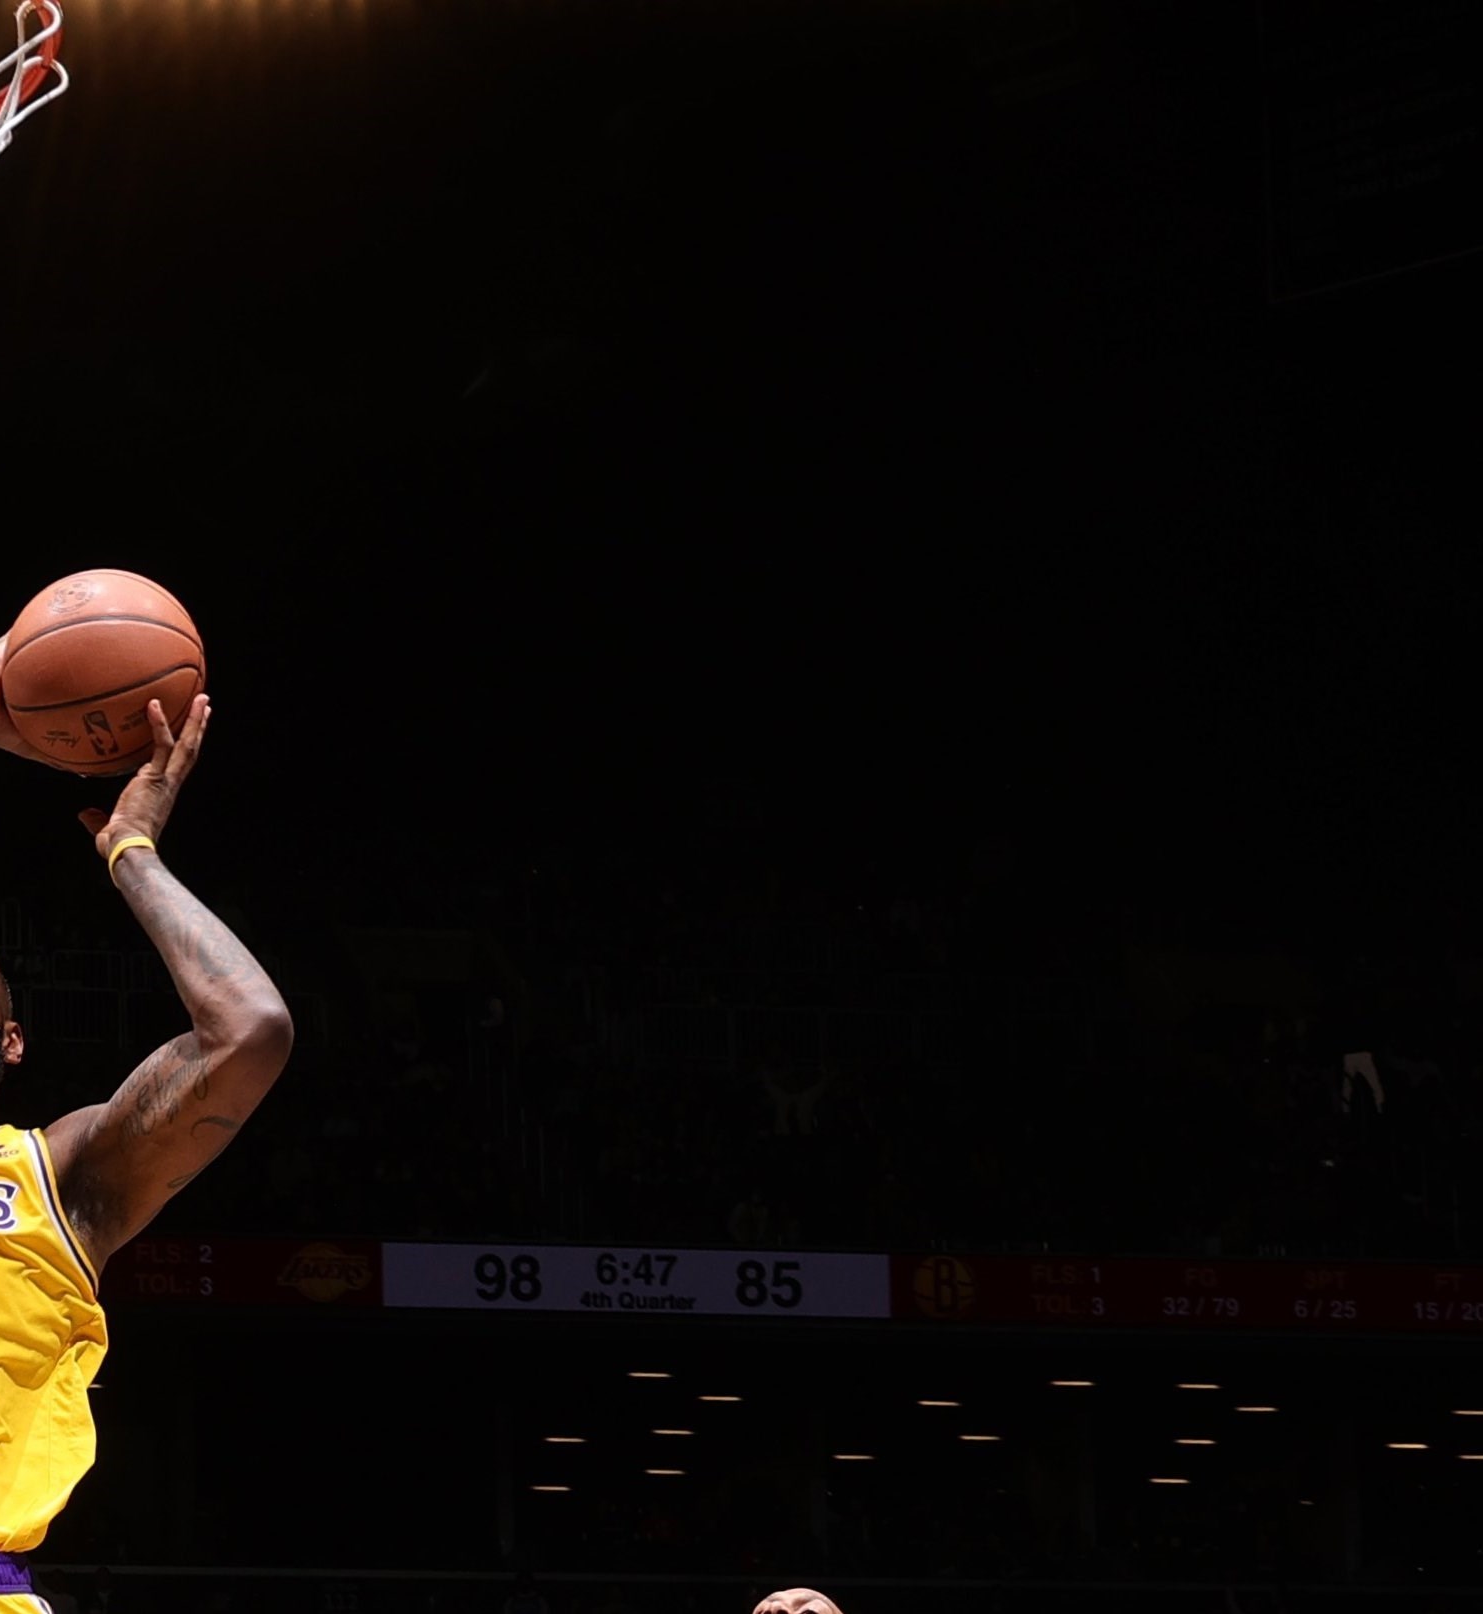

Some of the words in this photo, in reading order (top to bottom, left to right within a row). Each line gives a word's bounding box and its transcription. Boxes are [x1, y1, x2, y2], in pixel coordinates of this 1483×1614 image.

[198, 1244, 214, 1264] 2
[473, 1253, 543, 1302] 98
[596, 1253, 677, 1287] 6:47
[1091, 1266, 1102, 1285] 1
[198, 1277, 214, 1297] 3
[735, 1260, 803, 1308] 85
[580, 1291, 613, 1309] 4th
[619, 1292, 697, 1311] Quarter
[1092, 1296, 1106, 1317] 3
[1162, 1297, 1190, 1316] 32
[1213, 1298, 1241, 1318] 79
[1293, 1299, 1309, 1319] 6
[1330, 1300, 1357, 1319] 25
[1414, 1302, 1440, 1321] 15
